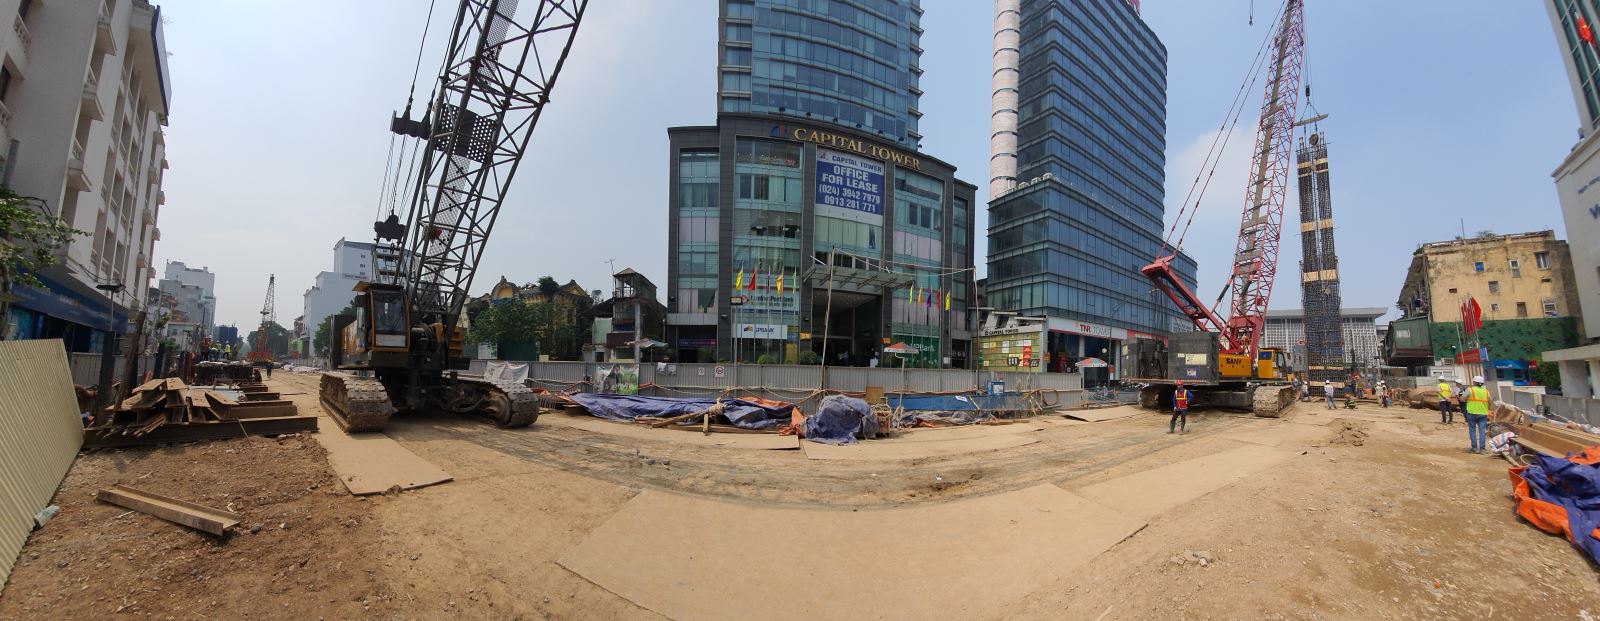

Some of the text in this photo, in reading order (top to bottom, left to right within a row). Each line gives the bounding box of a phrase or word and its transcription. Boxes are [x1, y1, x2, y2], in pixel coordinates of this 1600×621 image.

[793, 128, 922, 171] CAPITAL TOWER
[832, 155, 882, 173] CAPITAL TOWER
[833, 165, 869, 182] OFFICE
[822, 173, 878, 193] FOR LEASE
[819, 185, 881, 205] (024) 3942 7979
[824, 195, 876, 213] 0913 281 771
[1080, 324, 1091, 333] TNR
[1225, 357, 1243, 365] SANY
